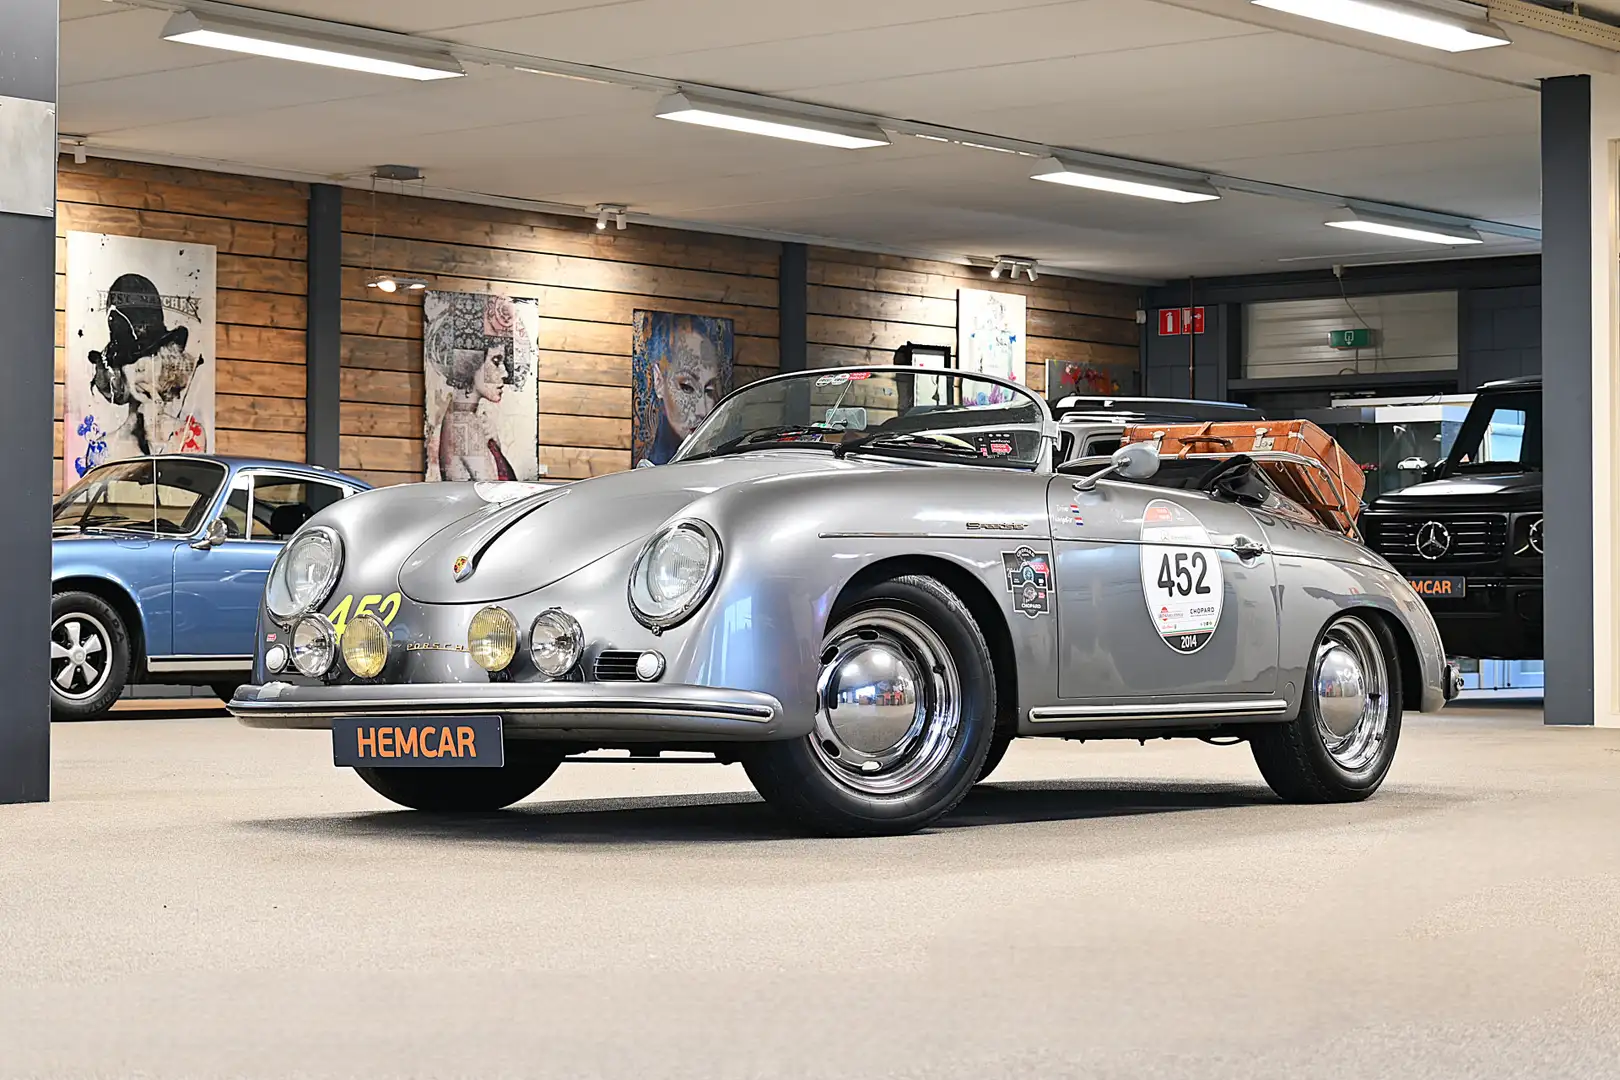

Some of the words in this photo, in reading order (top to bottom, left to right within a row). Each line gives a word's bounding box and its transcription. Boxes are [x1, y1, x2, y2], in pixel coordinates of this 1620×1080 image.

[1157, 551, 1211, 598] 452
[1409, 580, 1452, 594] MCAR
[1189, 606, 1215, 615] CHOPARD
[407, 642, 465, 651] PORSCH
[1180, 634, 1198, 649] 2014
[357, 726, 477, 758] HEMCAR
